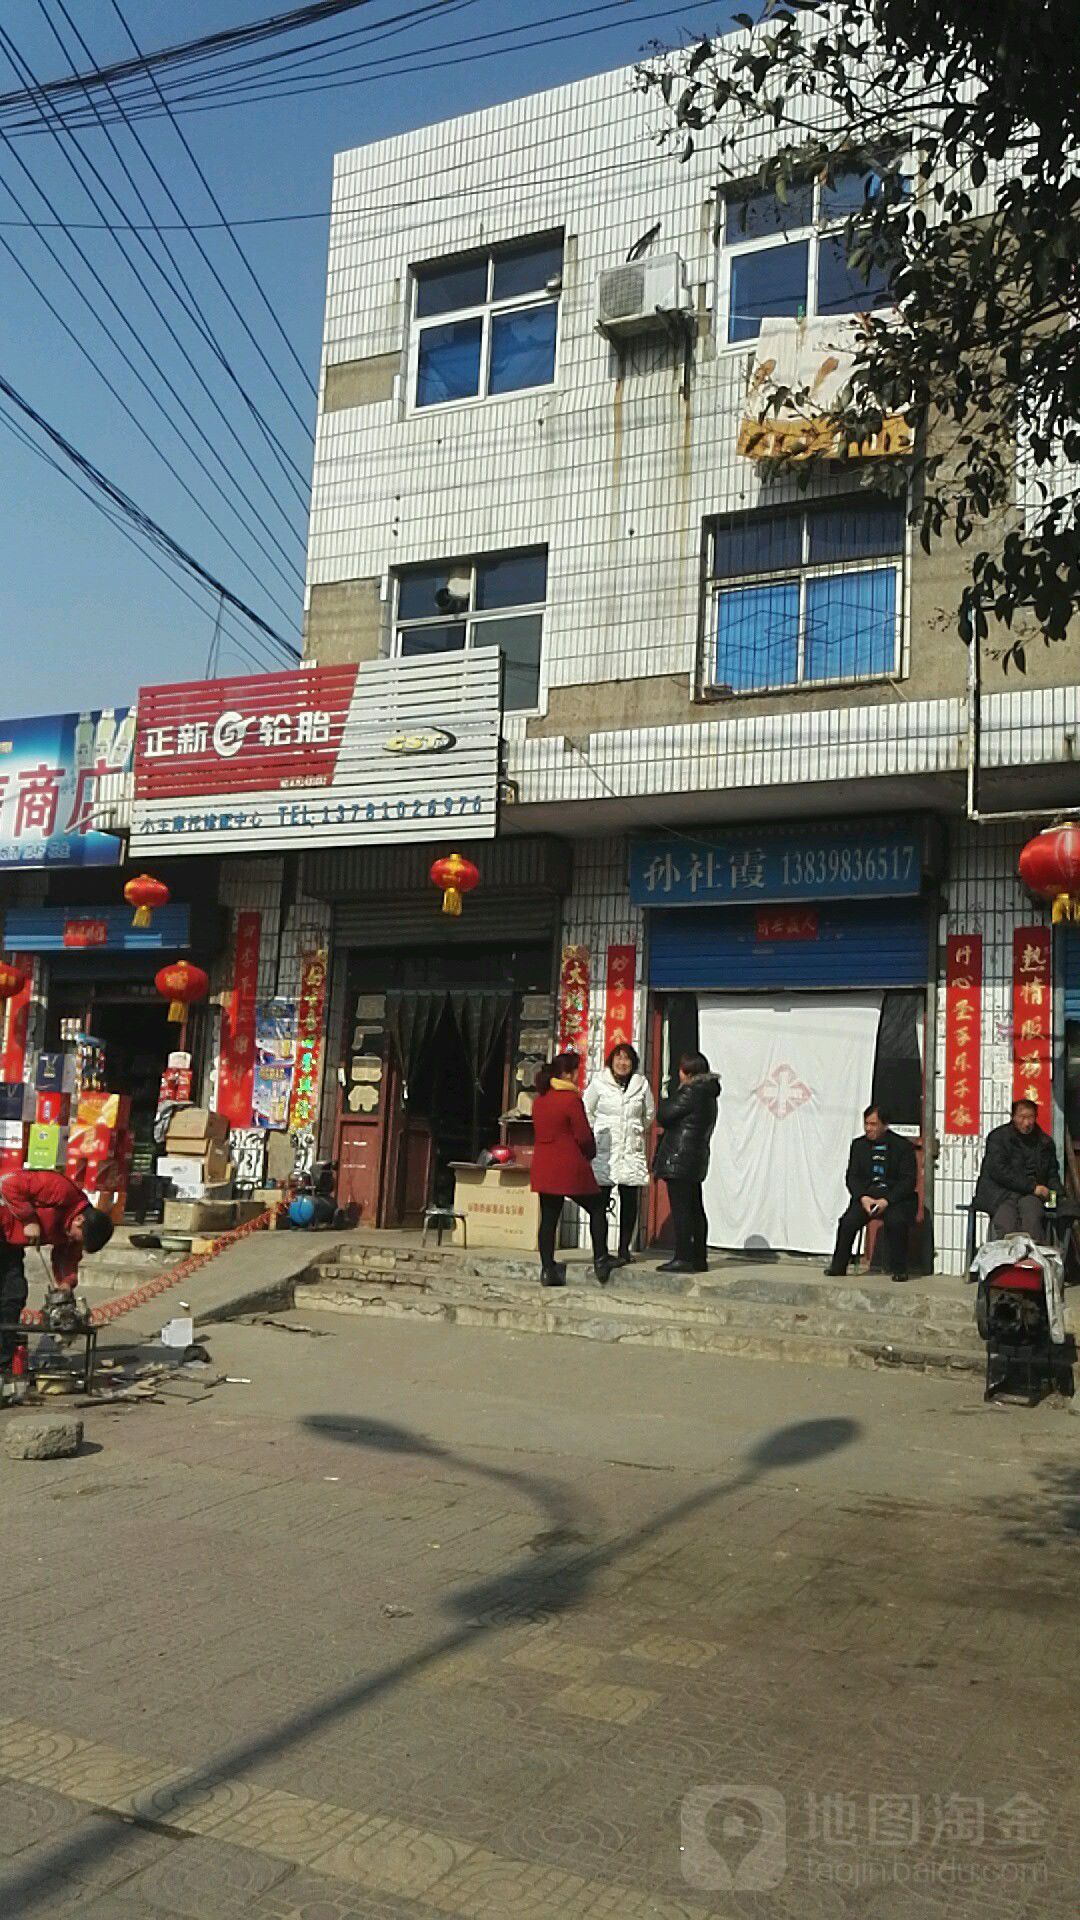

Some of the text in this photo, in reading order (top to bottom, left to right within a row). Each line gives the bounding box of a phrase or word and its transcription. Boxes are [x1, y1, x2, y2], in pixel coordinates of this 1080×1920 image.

[144, 710, 331, 758] 正新 轮胎
[643, 846, 915, 893] 孙社霞 13839836517
